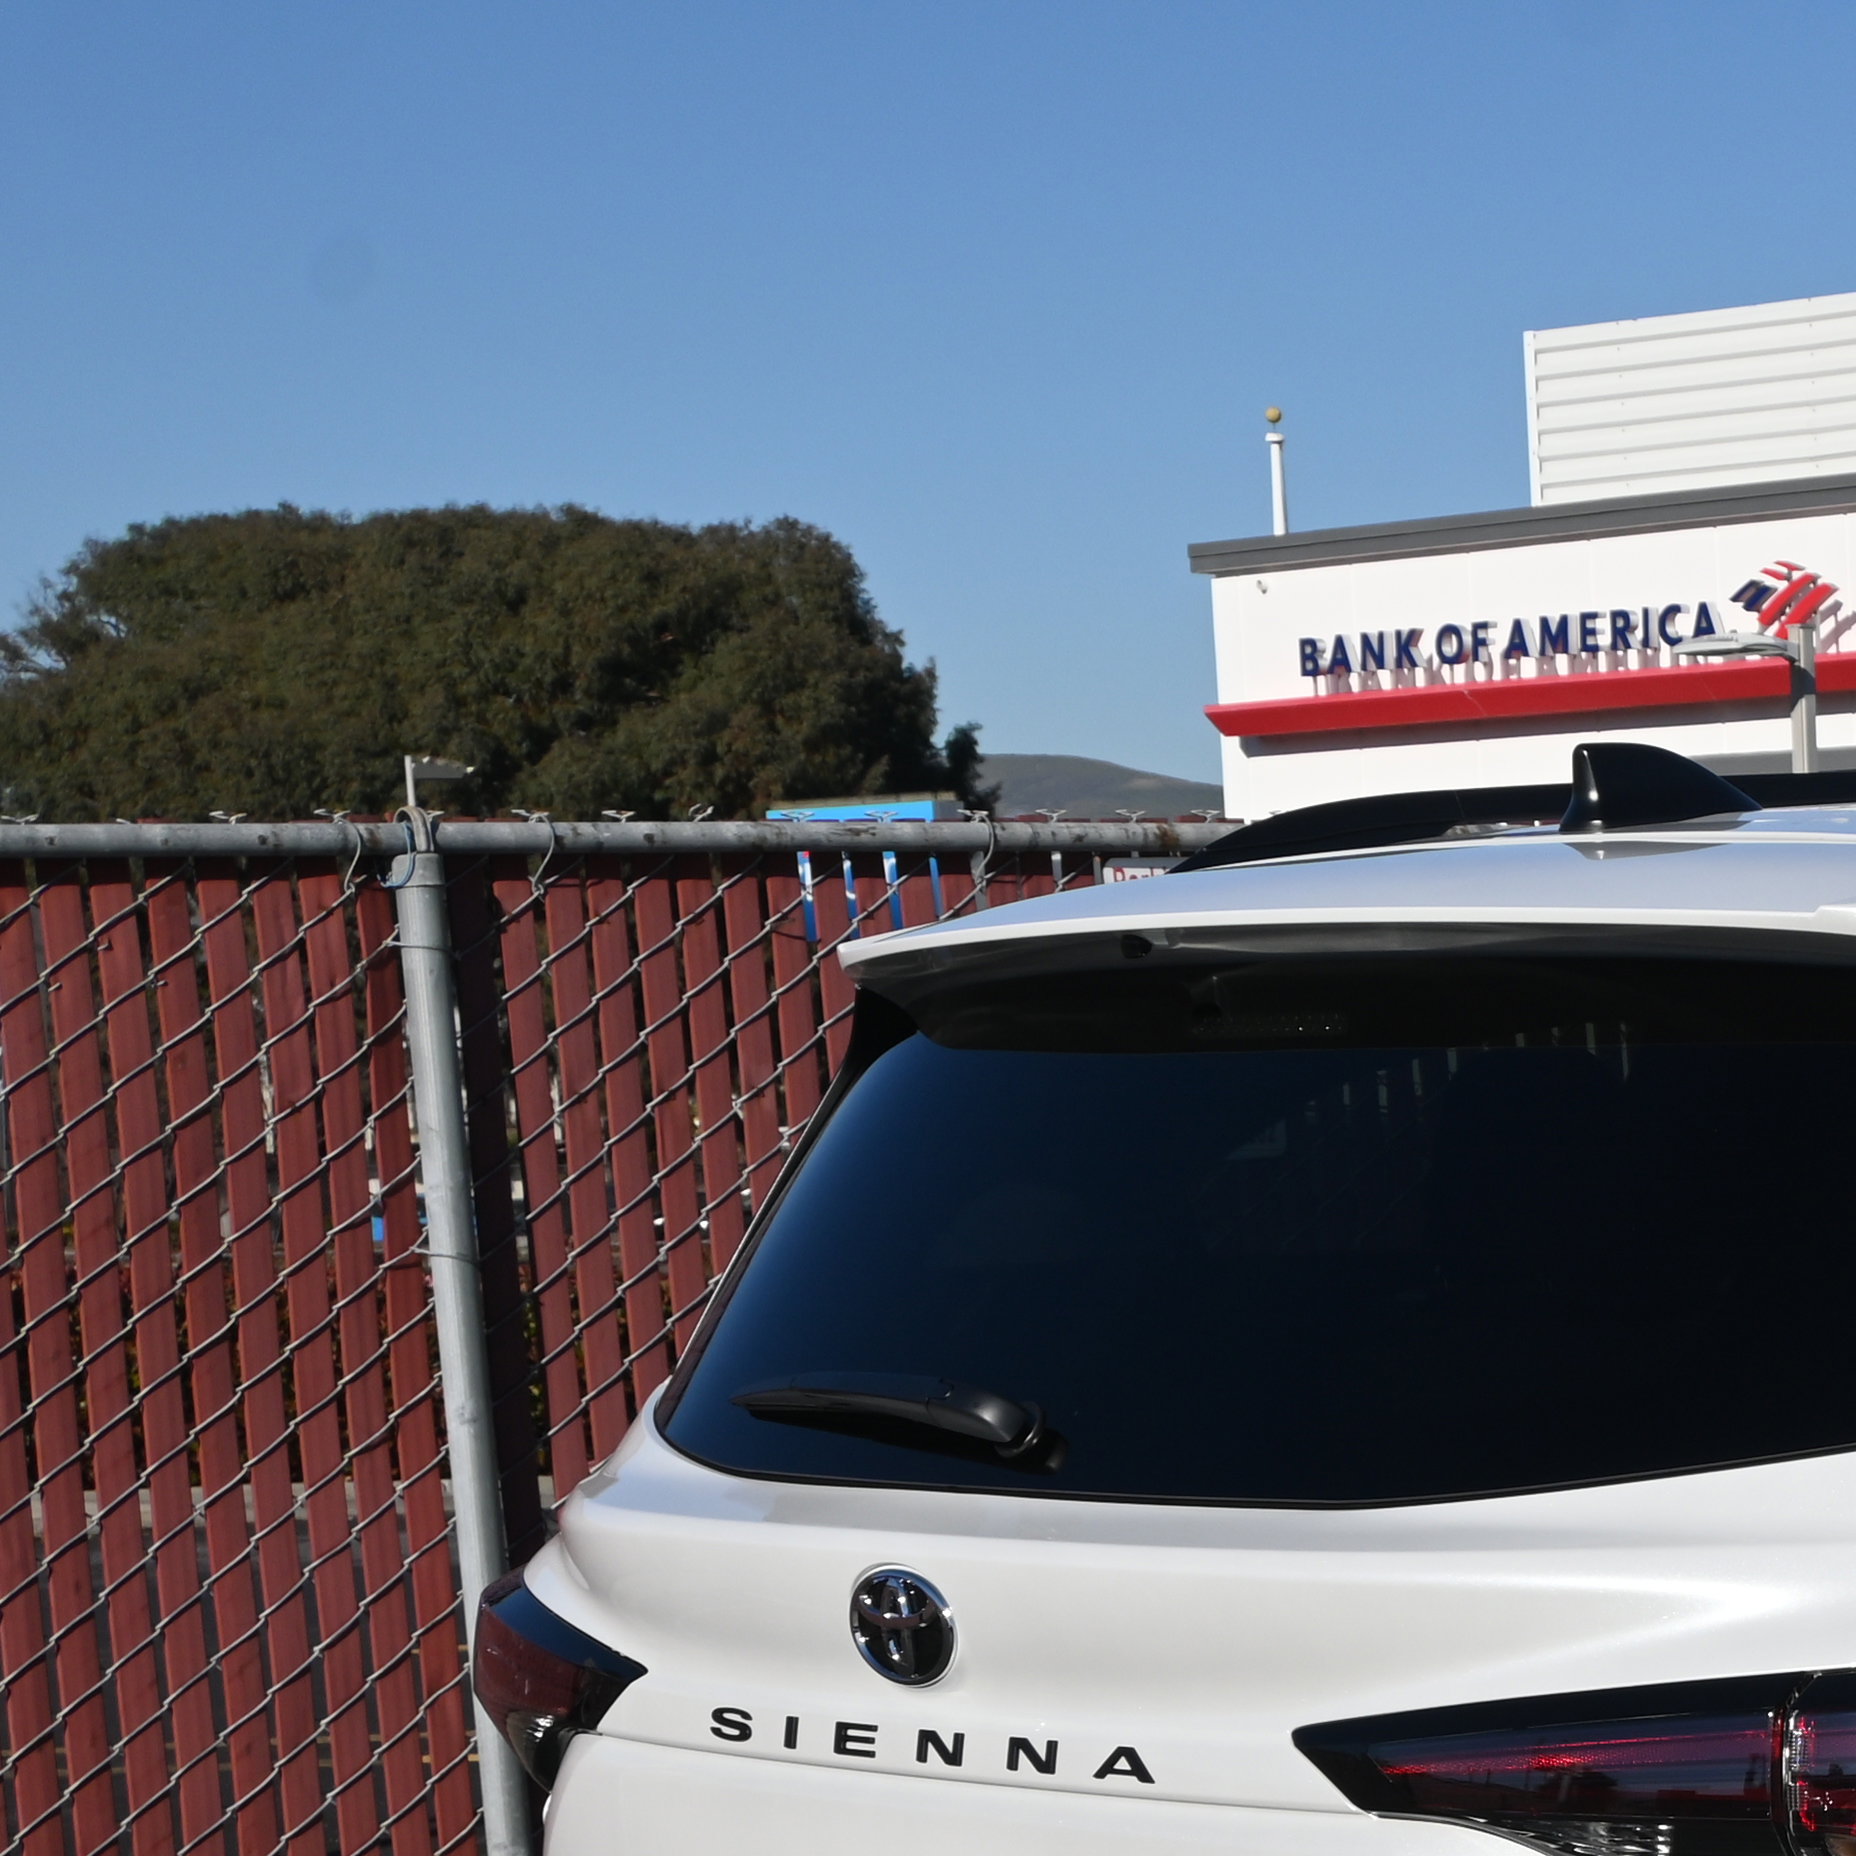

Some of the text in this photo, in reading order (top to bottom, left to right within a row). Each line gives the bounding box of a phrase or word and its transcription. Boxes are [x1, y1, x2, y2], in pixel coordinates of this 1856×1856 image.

[1299, 602, 1725, 677] BANK OF AMERICA
[710, 1706, 1157, 1785] SIENNA
